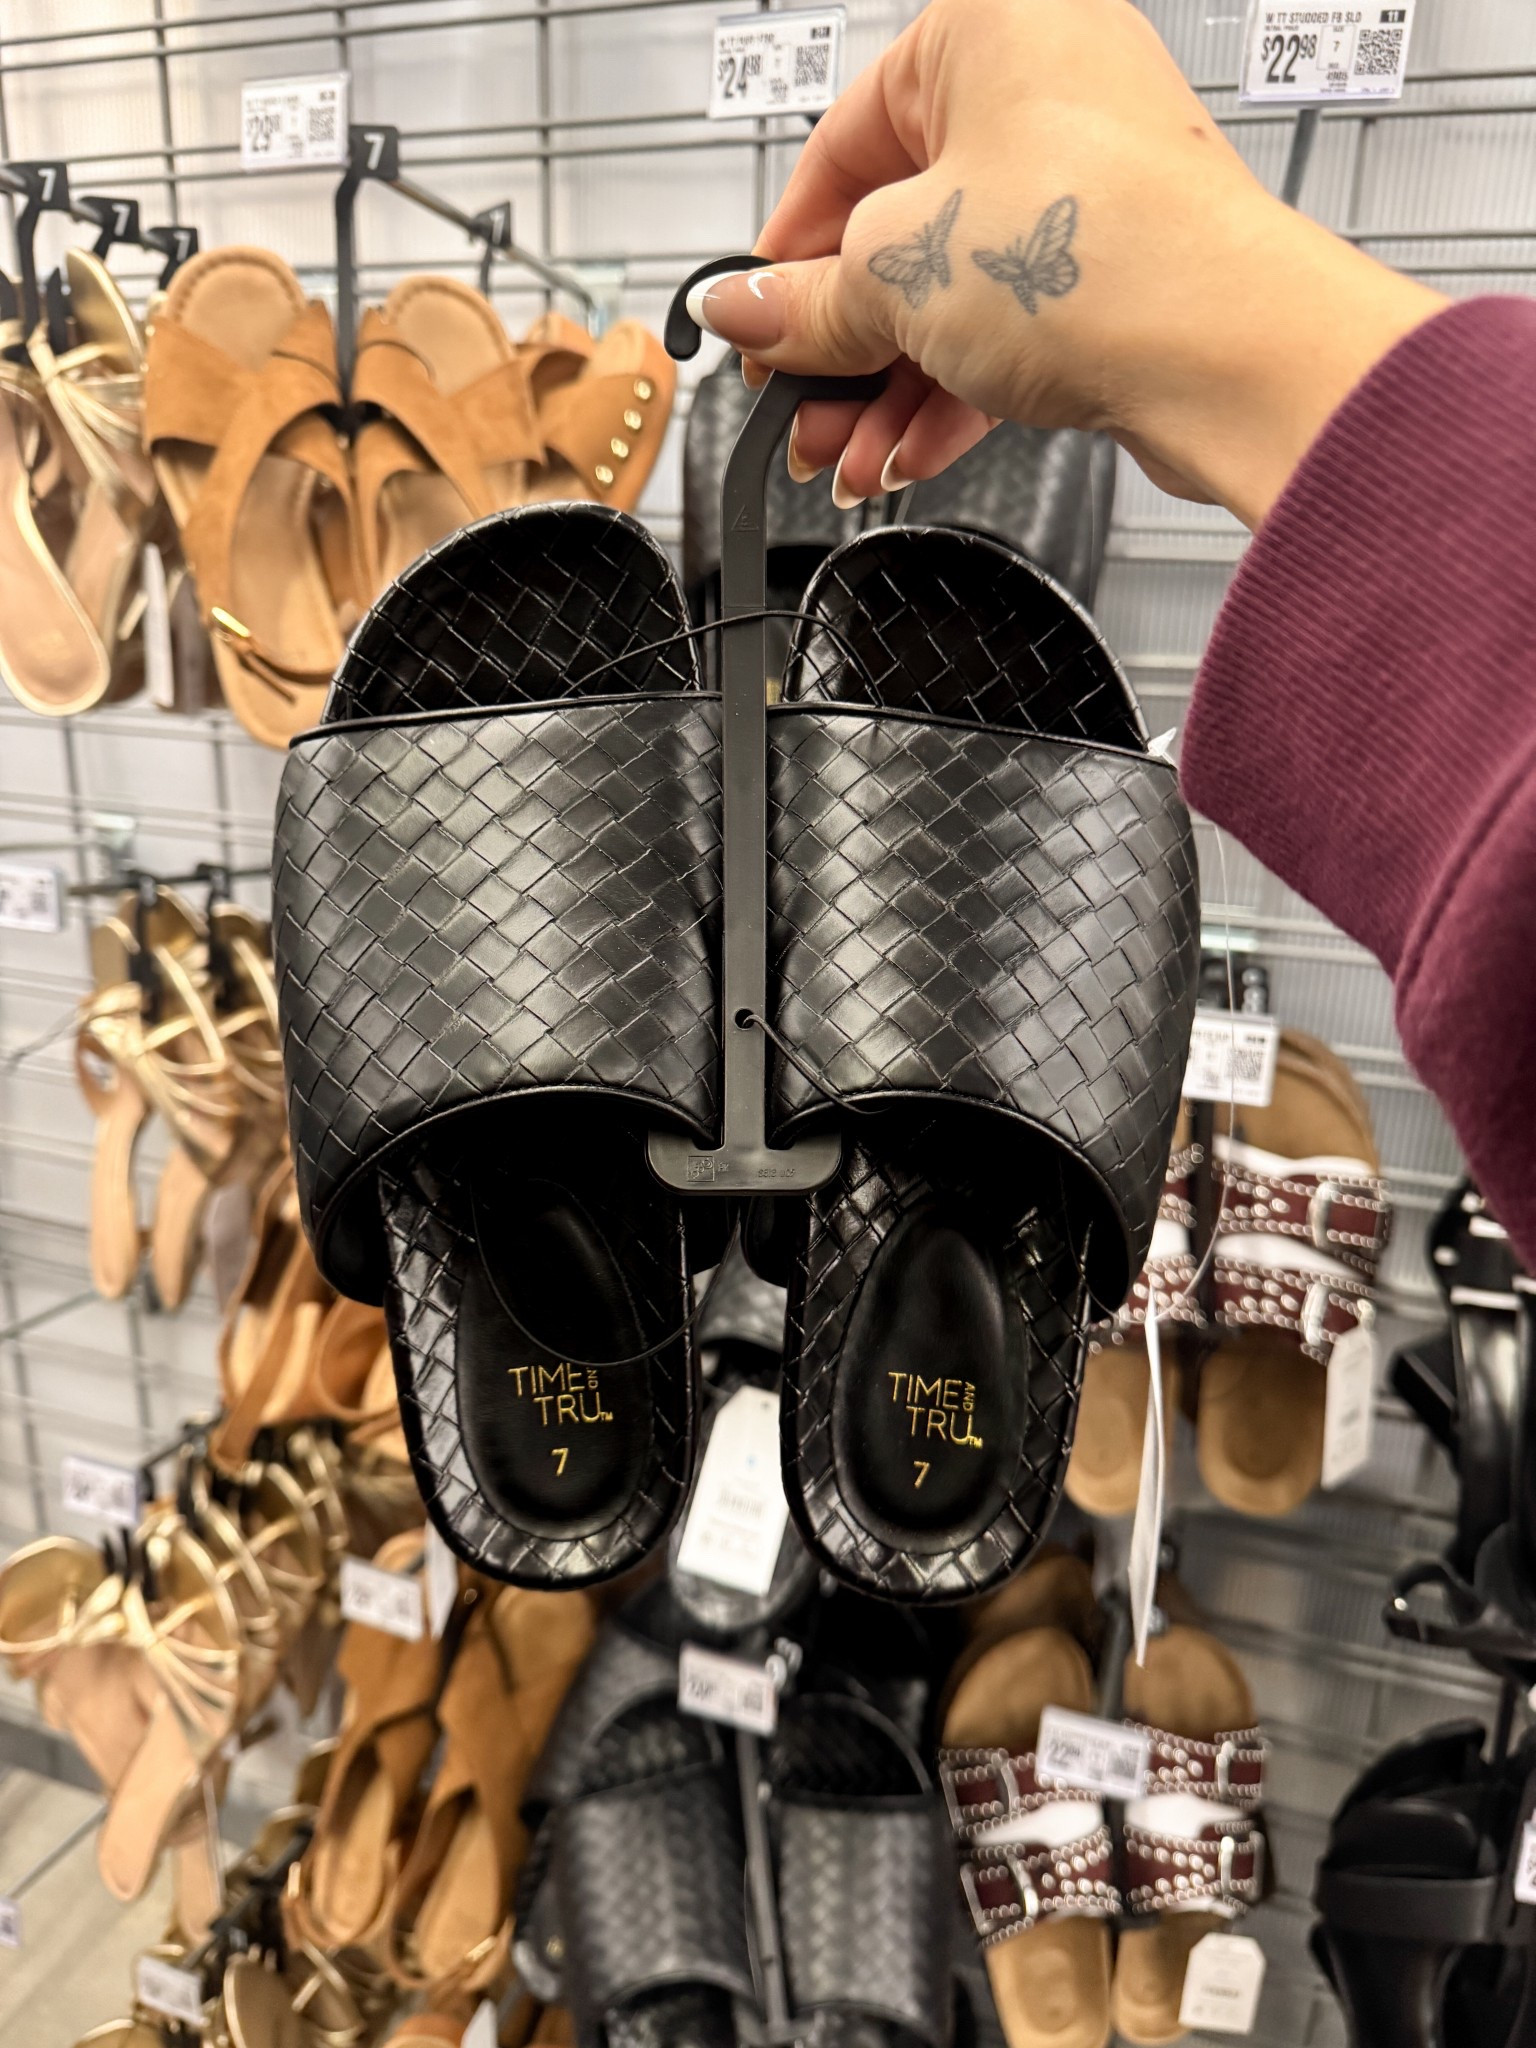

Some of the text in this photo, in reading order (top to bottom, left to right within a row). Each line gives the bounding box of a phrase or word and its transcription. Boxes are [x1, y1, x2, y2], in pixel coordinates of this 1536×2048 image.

[1265, 12, 1275, 23] W
[1276, 12, 1288, 23] TT
[363, 131, 386, 170] 7
[37, 167, 57, 202] 7
[111, 203, 131, 237] 7
[173, 230, 191, 262] 7
[507, 1362, 585, 1397] TIME
[888, 1371, 976, 1413] TIME AND
[532, 1391, 601, 1426] TRU
[905, 1405, 974, 1446] TRU
[551, 1447, 569, 1477] 7
[913, 1460, 930, 1489] 7
